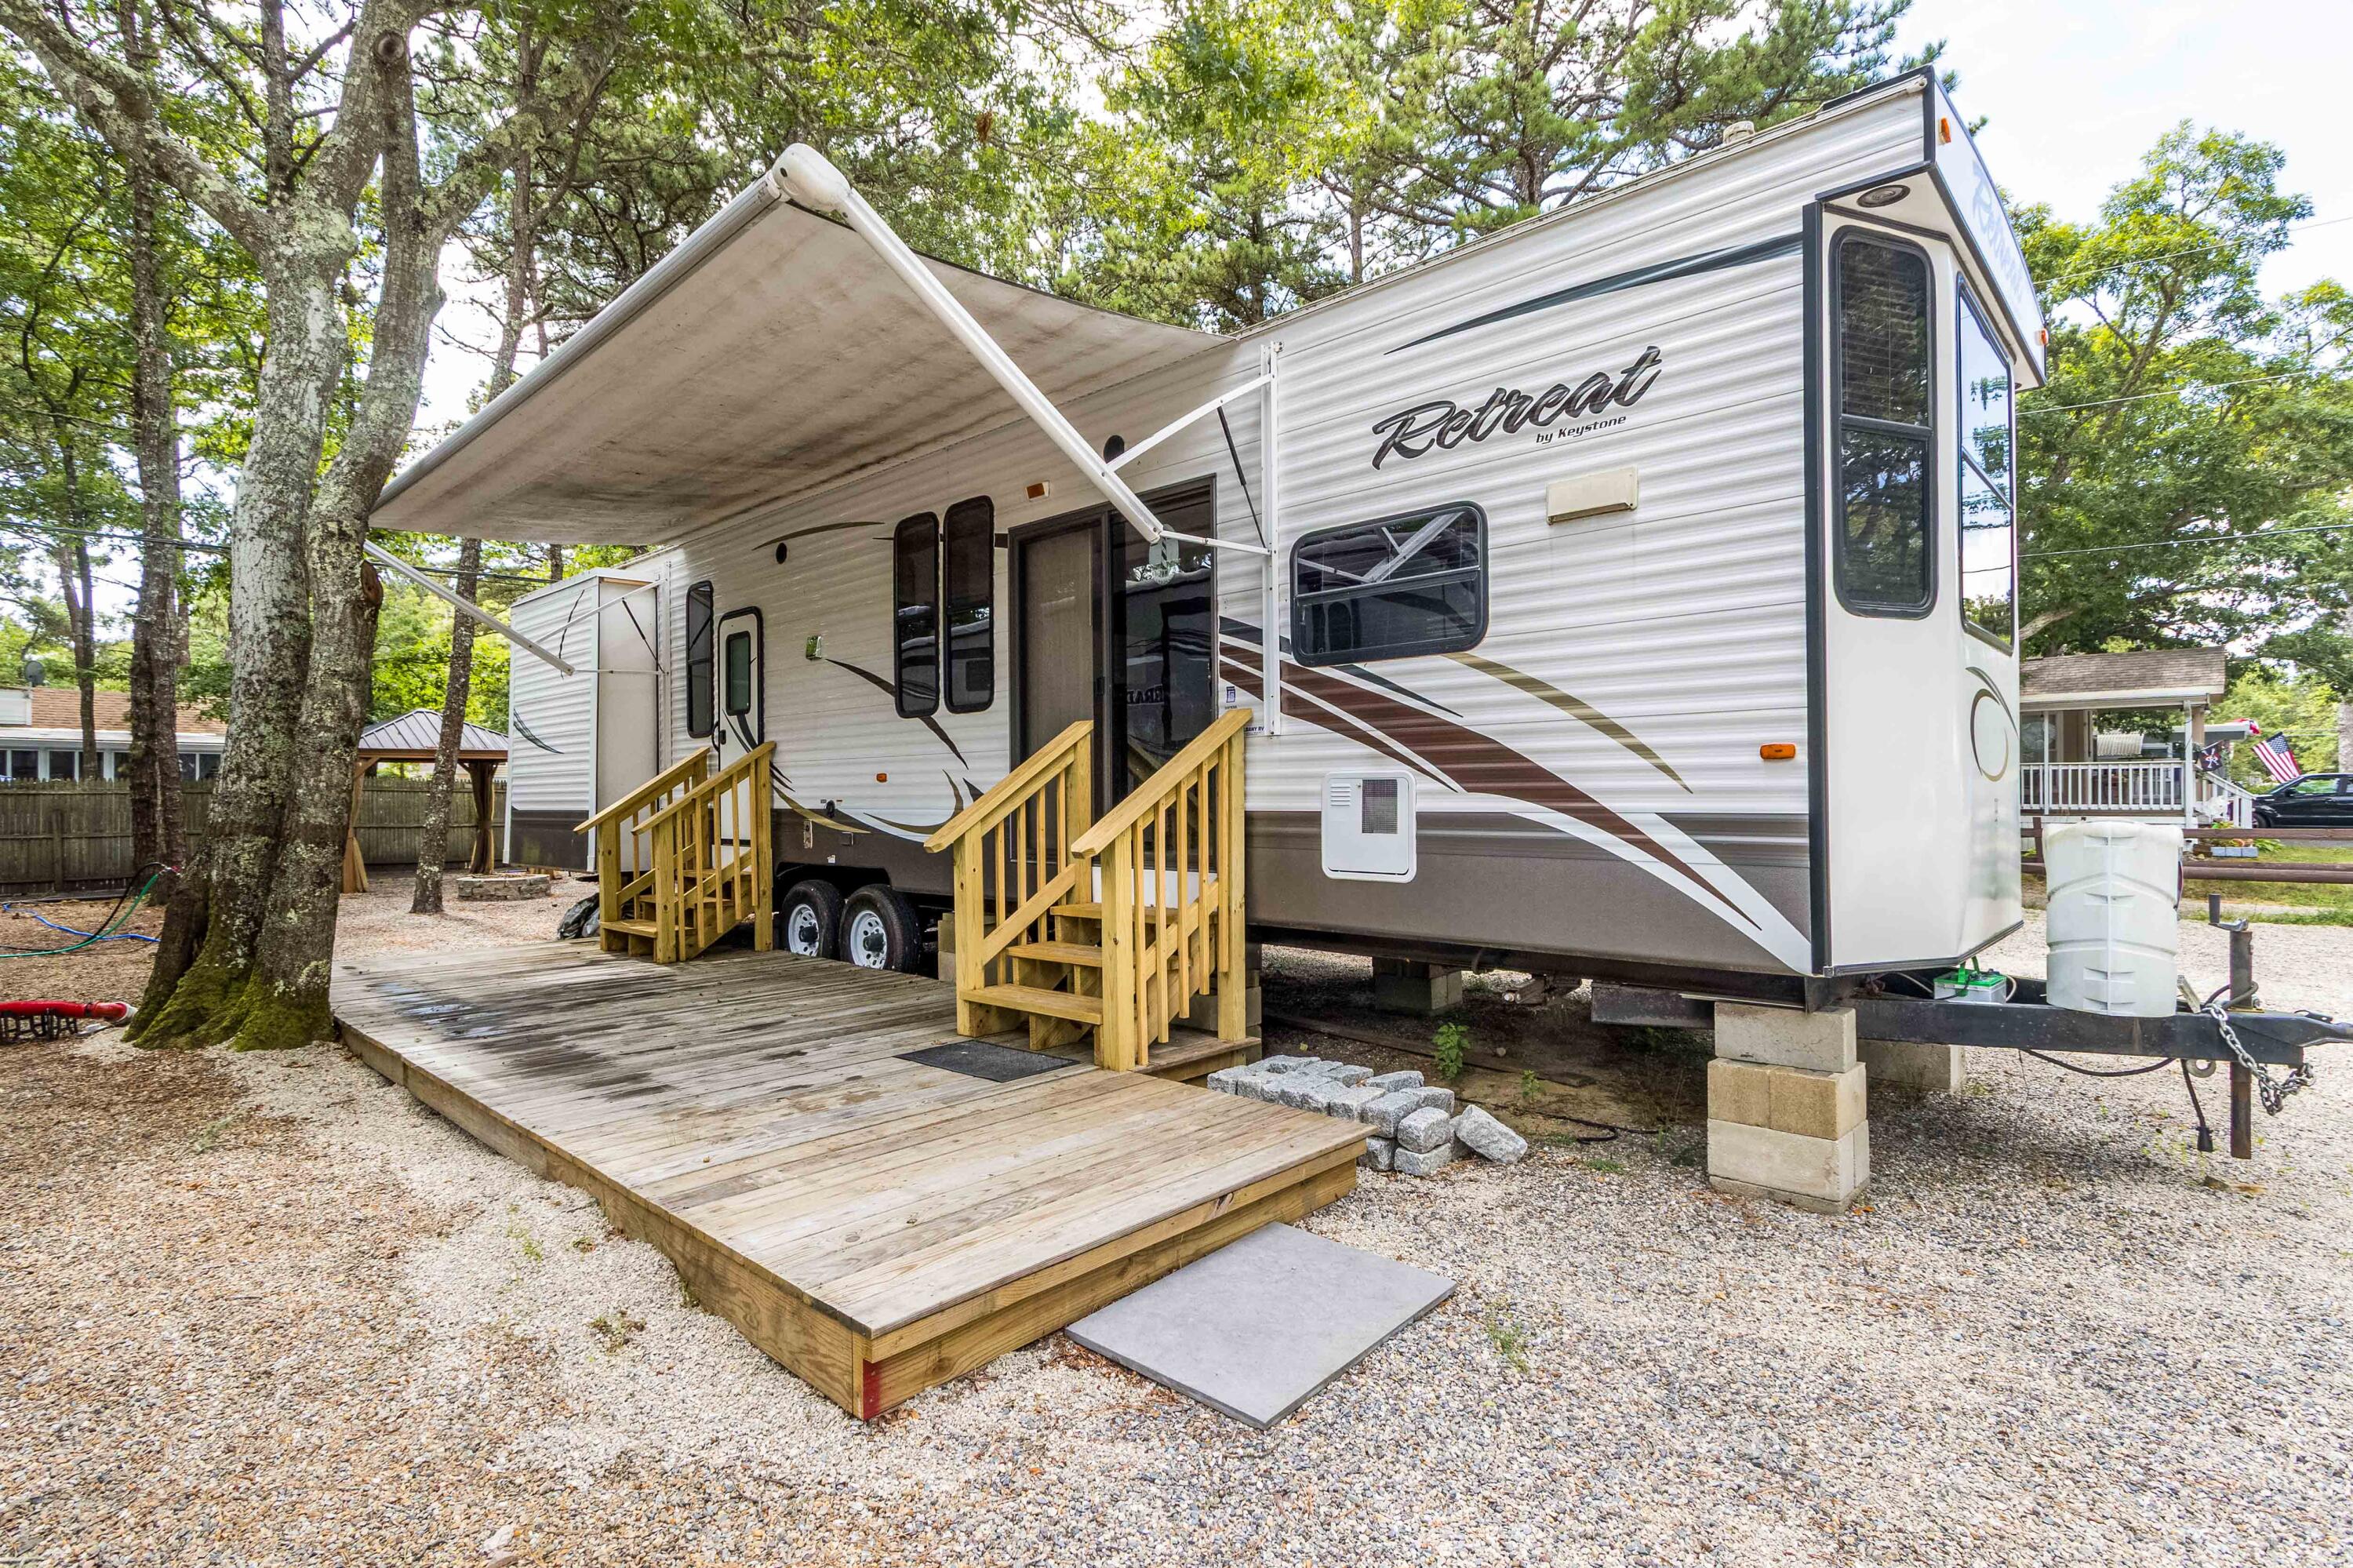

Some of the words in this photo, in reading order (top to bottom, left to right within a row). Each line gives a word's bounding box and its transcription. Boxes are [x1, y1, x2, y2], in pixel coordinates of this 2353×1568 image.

[1372, 346, 1662, 470] Retreat
[1536, 433, 1554, 445] by
[1558, 416, 1627, 438] Keystone
